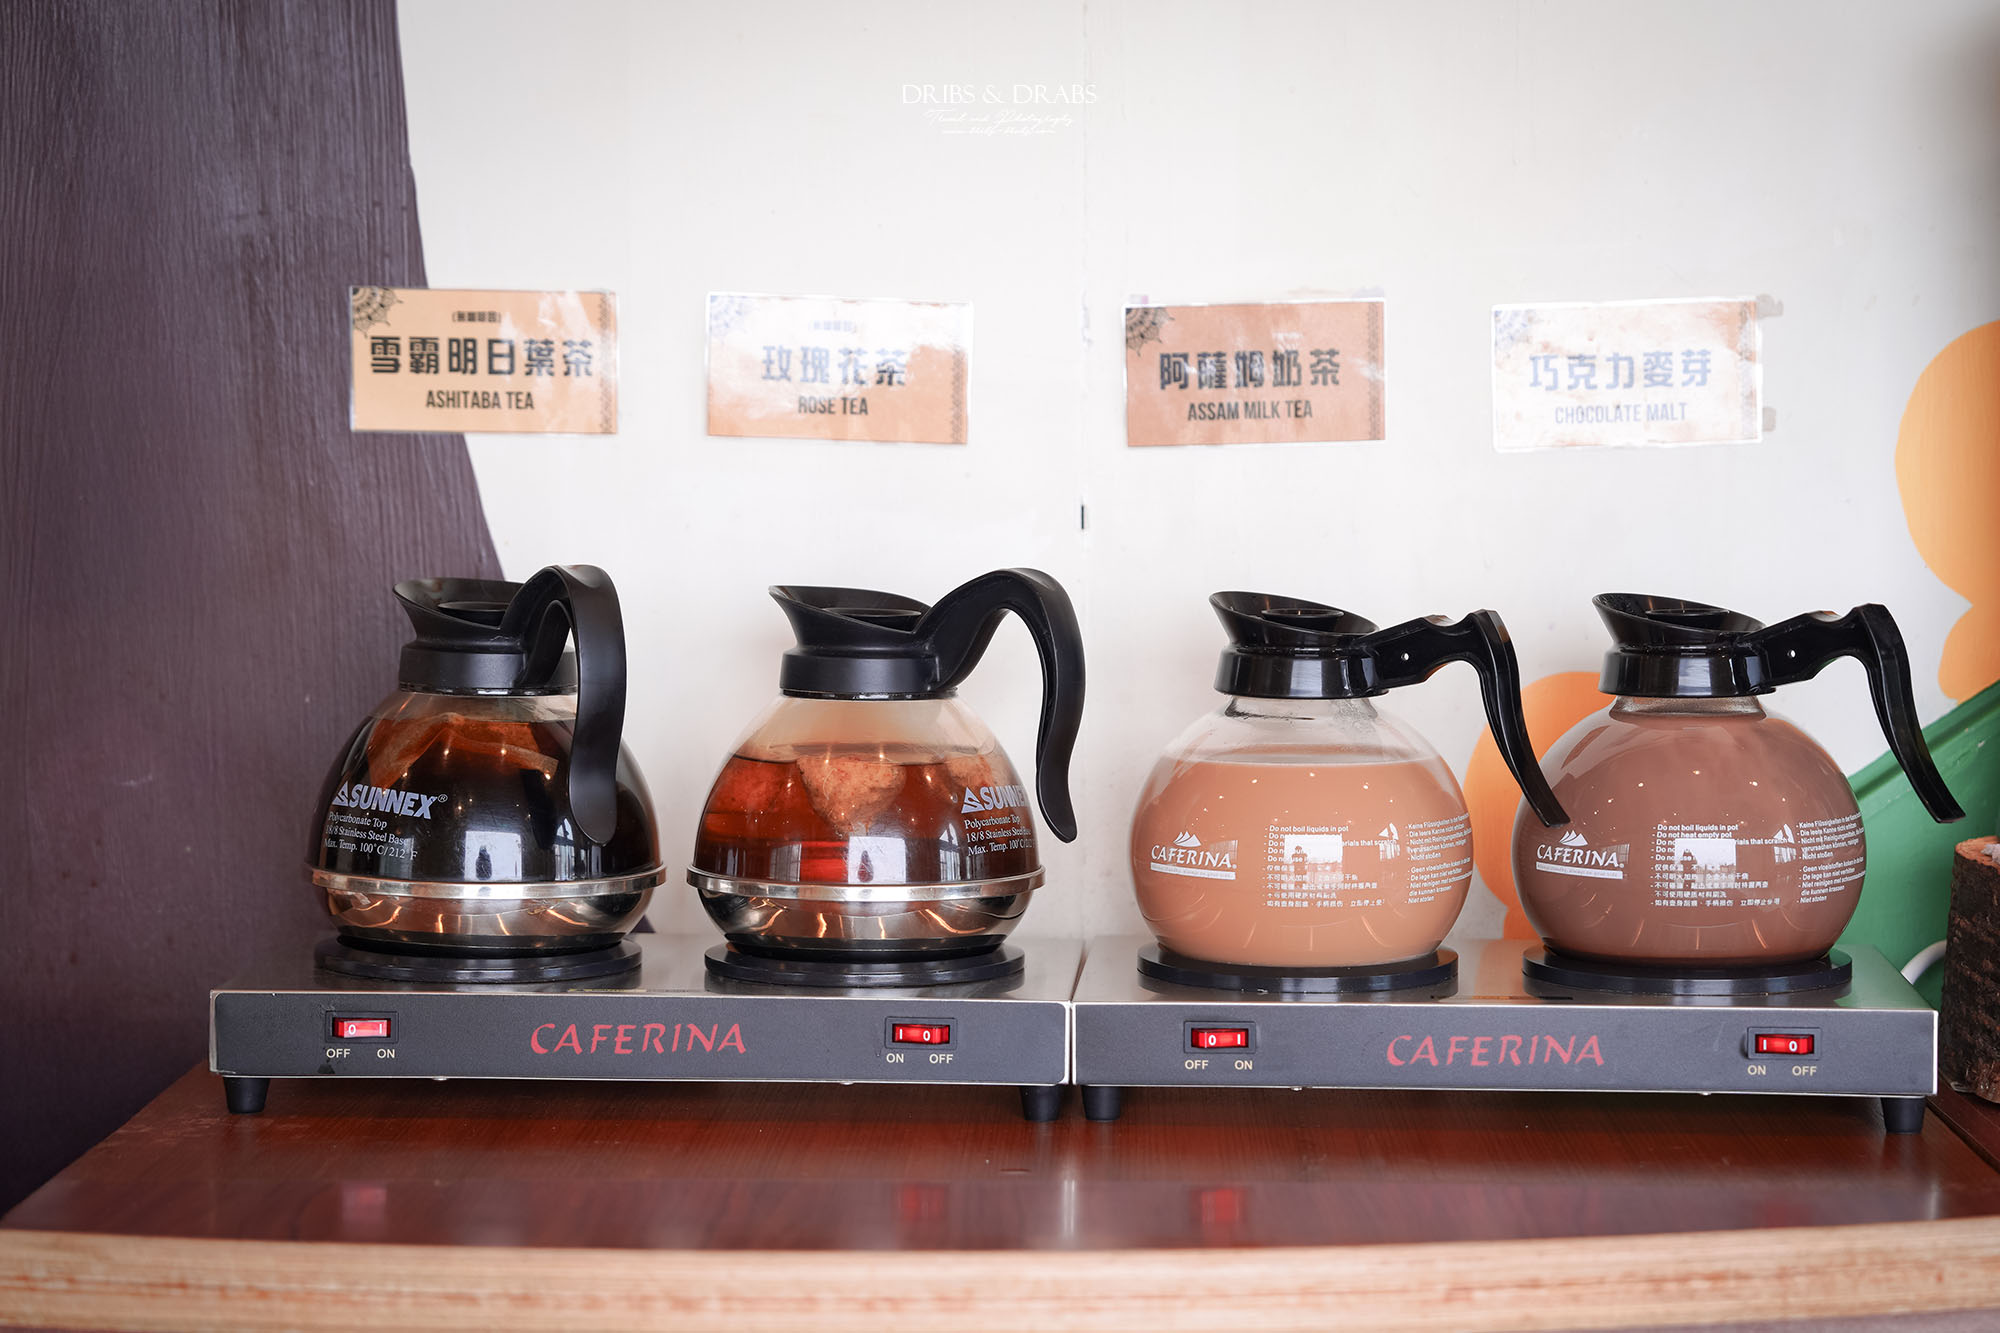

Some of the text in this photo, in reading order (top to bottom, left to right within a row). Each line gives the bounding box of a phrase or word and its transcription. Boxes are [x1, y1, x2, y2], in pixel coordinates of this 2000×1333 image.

[371, 336, 593, 376] 雪霸明日葉茶
[761, 345, 907, 386] 玫瑰花茶
[1160, 349, 1340, 390] 阿薩姆奶茶
[1529, 349, 1712, 392] 巧克力麥芽
[426, 390, 534, 410] ASHITABA TEA
[798, 397, 868, 415] ROSE TEA
[1188, 400, 1312, 421] ASSAM MILK TEA
[1555, 402, 1688, 425] CHOCOLATE MALT
[328, 812, 387, 830] Polycarbonate Top
[964, 815, 1020, 829] Polycarbonate Top
[1695, 824, 1718, 832] liquids
[339, 826, 366, 839] Stainless
[368, 831, 387, 841] Steel
[966, 832, 984, 842] 18/8
[986, 829, 1011, 839] Stainless
[339, 839, 357, 852] Temp.
[968, 842, 1008, 857] Max. Temp.
[1814, 879, 1833, 887] reinigen
[530, 1022, 747, 1054] CAFERINA
[326, 1048, 396, 1059] OFF ON
[886, 1052, 954, 1064] ON OFF
[1387, 1034, 1605, 1067] CAFERINA
[1184, 1059, 1253, 1070] OFF ON
[1747, 1065, 1817, 1077] ON OFF
